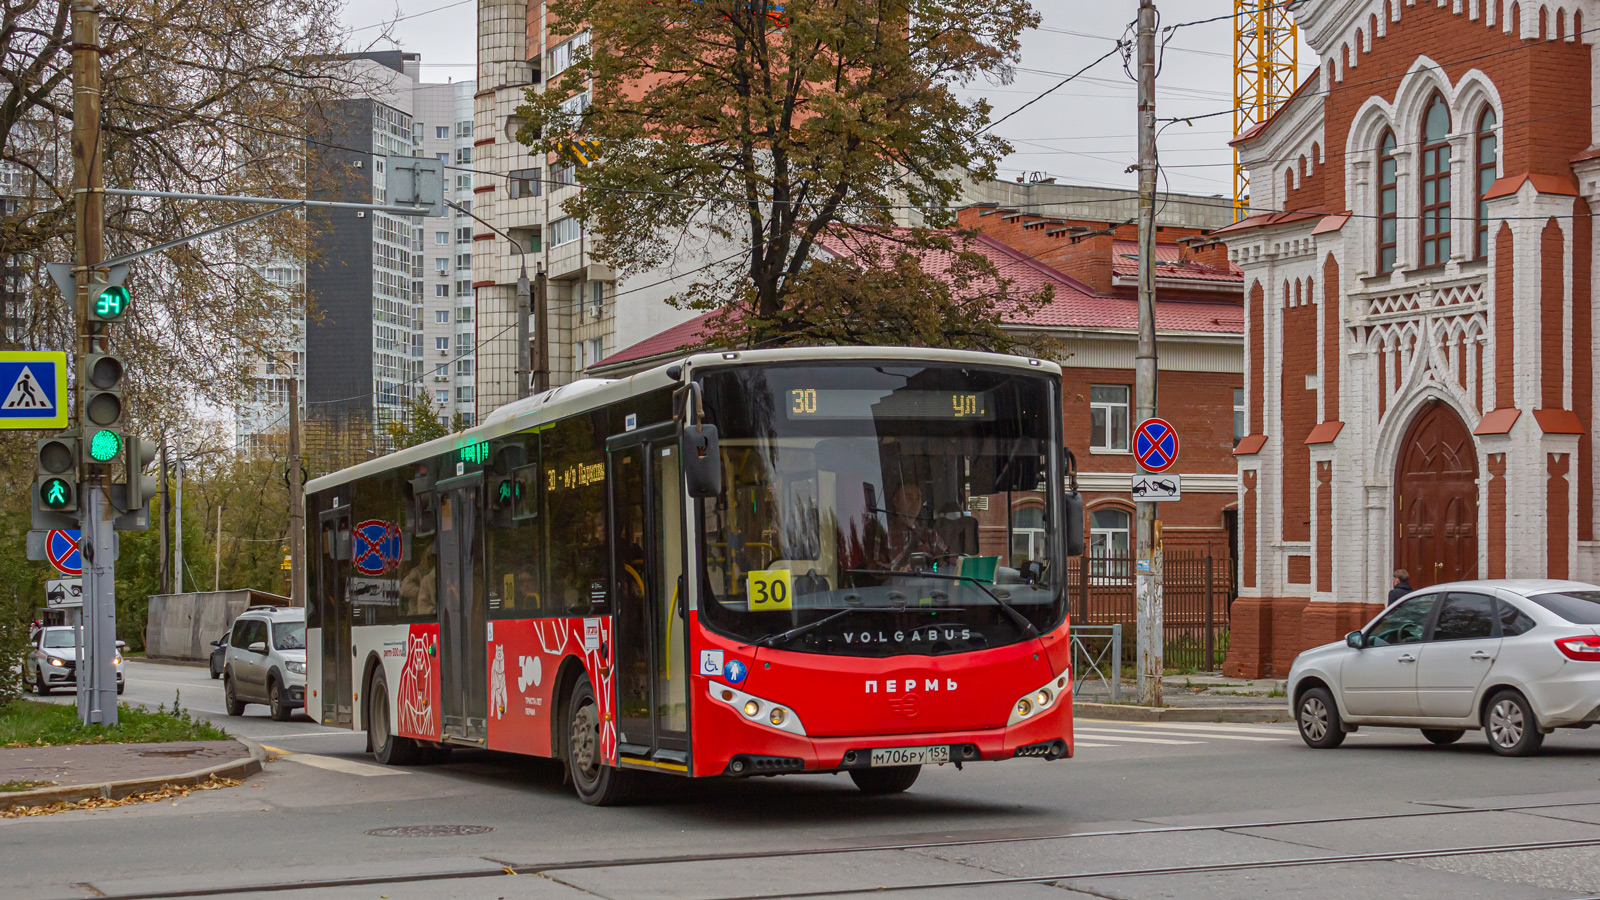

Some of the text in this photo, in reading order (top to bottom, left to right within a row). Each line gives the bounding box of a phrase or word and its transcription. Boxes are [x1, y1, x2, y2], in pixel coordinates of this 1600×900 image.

[97, 293, 120, 314] 34
[792, 389, 816, 413] 30
[548, 469, 556, 490] 30
[754, 579, 787, 604] 30
[843, 629, 970, 643] VOLGABUS
[517, 655, 542, 693] 300
[865, 678, 958, 693] ПЕРМЬ
[928, 746, 947, 758] 159
